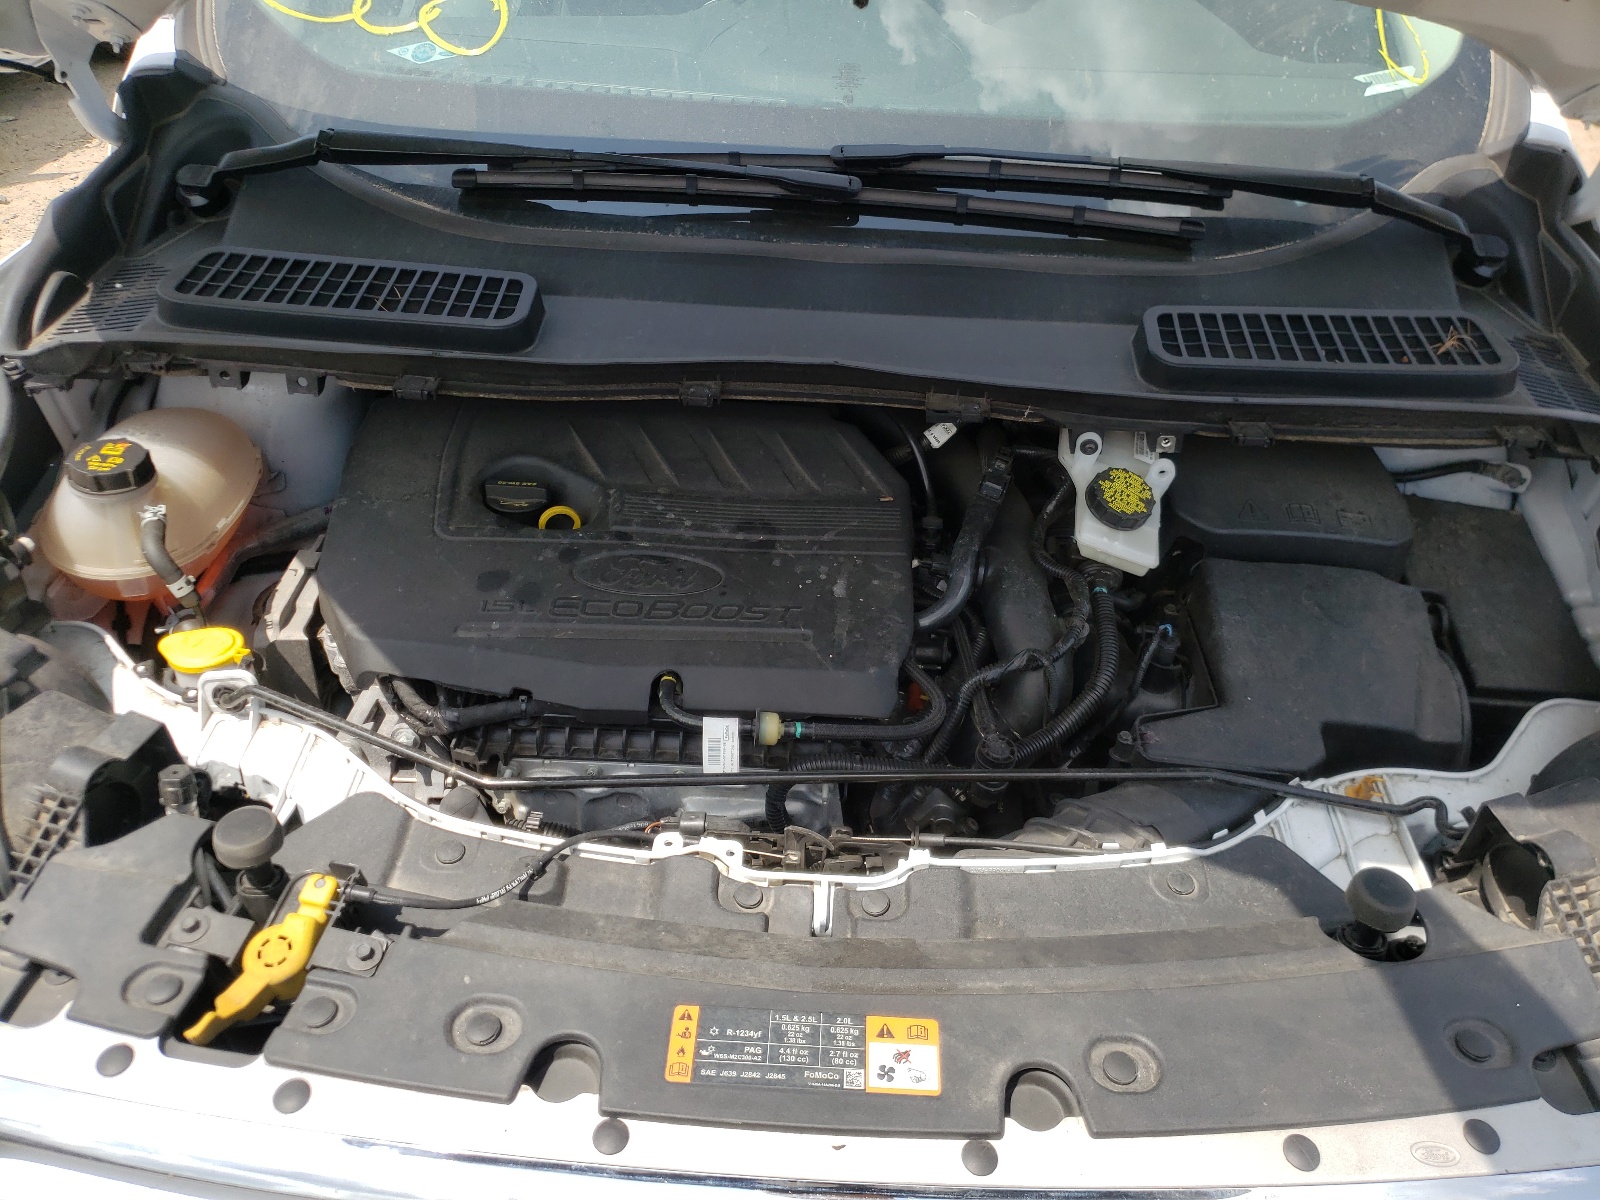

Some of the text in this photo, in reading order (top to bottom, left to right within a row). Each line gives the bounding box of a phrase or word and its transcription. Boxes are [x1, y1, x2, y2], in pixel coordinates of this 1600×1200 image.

[600, 556, 701, 590] Ford
[481, 599, 538, 613] 1.5L
[774, 1014, 792, 1022] 1.5L
[726, 1029, 762, 1039] R-1234yf
[801, 1025, 810, 1034] kg
[849, 1028, 859, 1036] kg
[779, 1055, 809, 1064] (130 cc)
[831, 1058, 857, 1067] (80 cc)
[740, 1071, 761, 1079] J2842
[804, 1071, 839, 1080] FoMoCo
